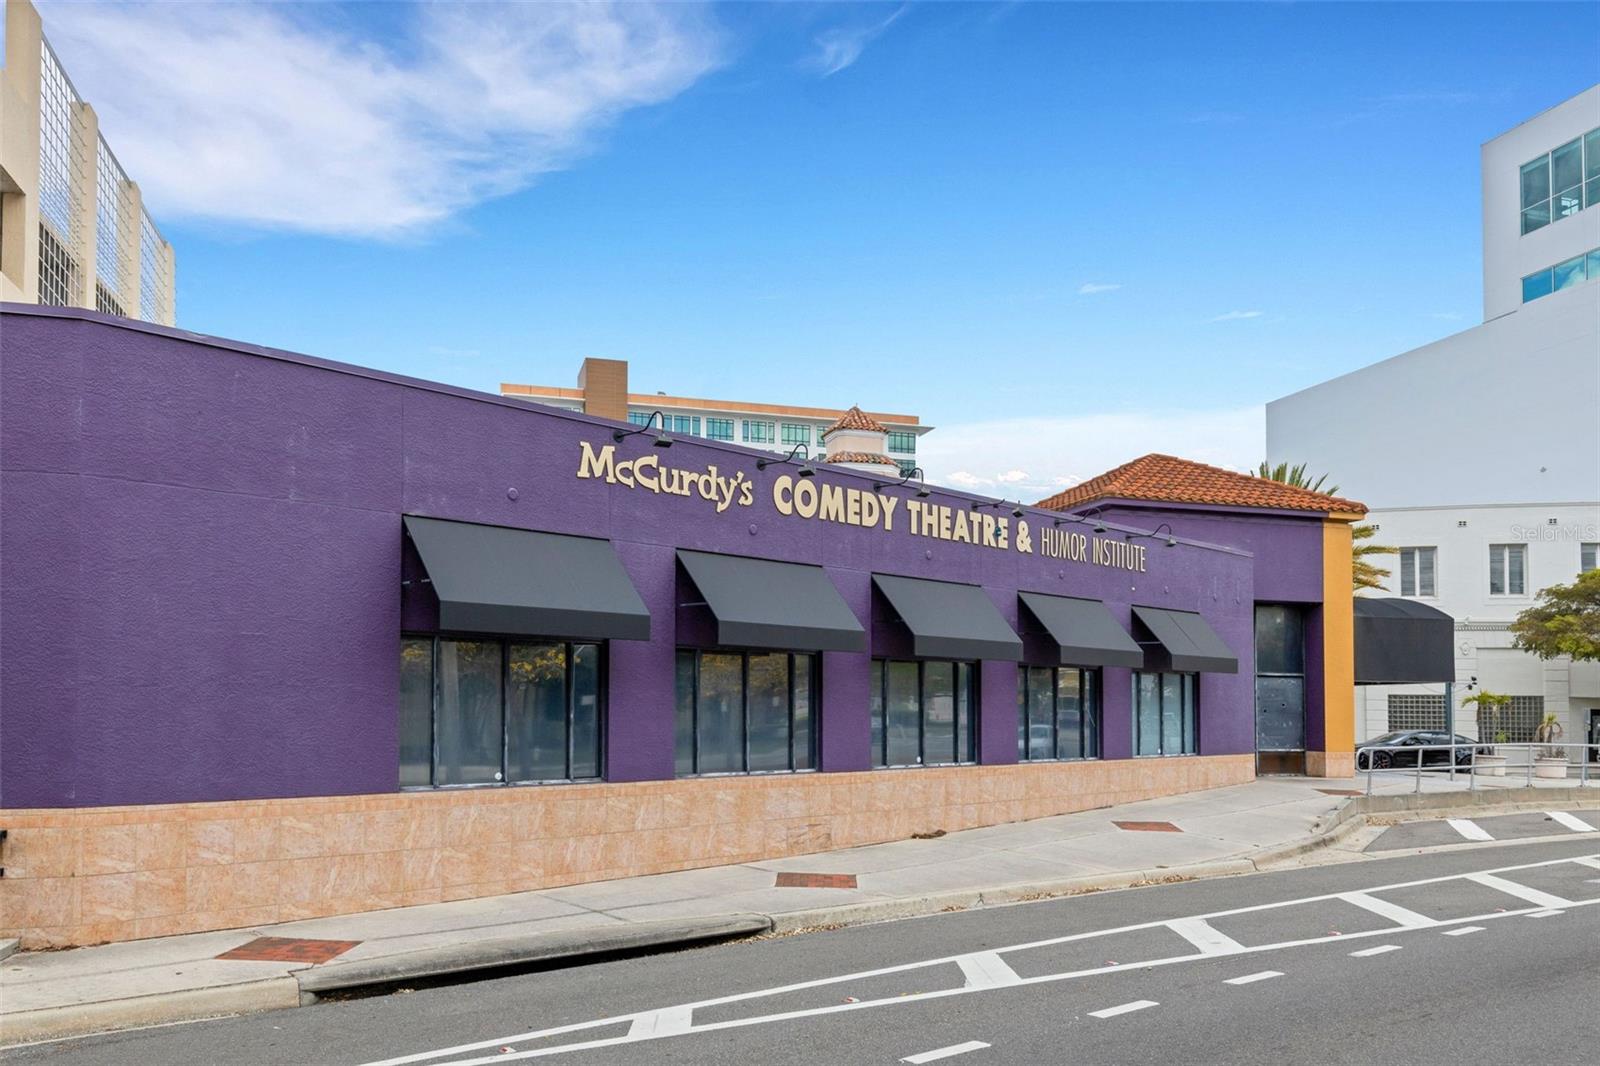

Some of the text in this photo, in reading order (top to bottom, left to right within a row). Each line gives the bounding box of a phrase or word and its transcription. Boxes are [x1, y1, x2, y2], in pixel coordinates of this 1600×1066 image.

[576, 441, 1146, 572] McCurdy's COMEDY THEATRE & HUMOR INSTITUTE
